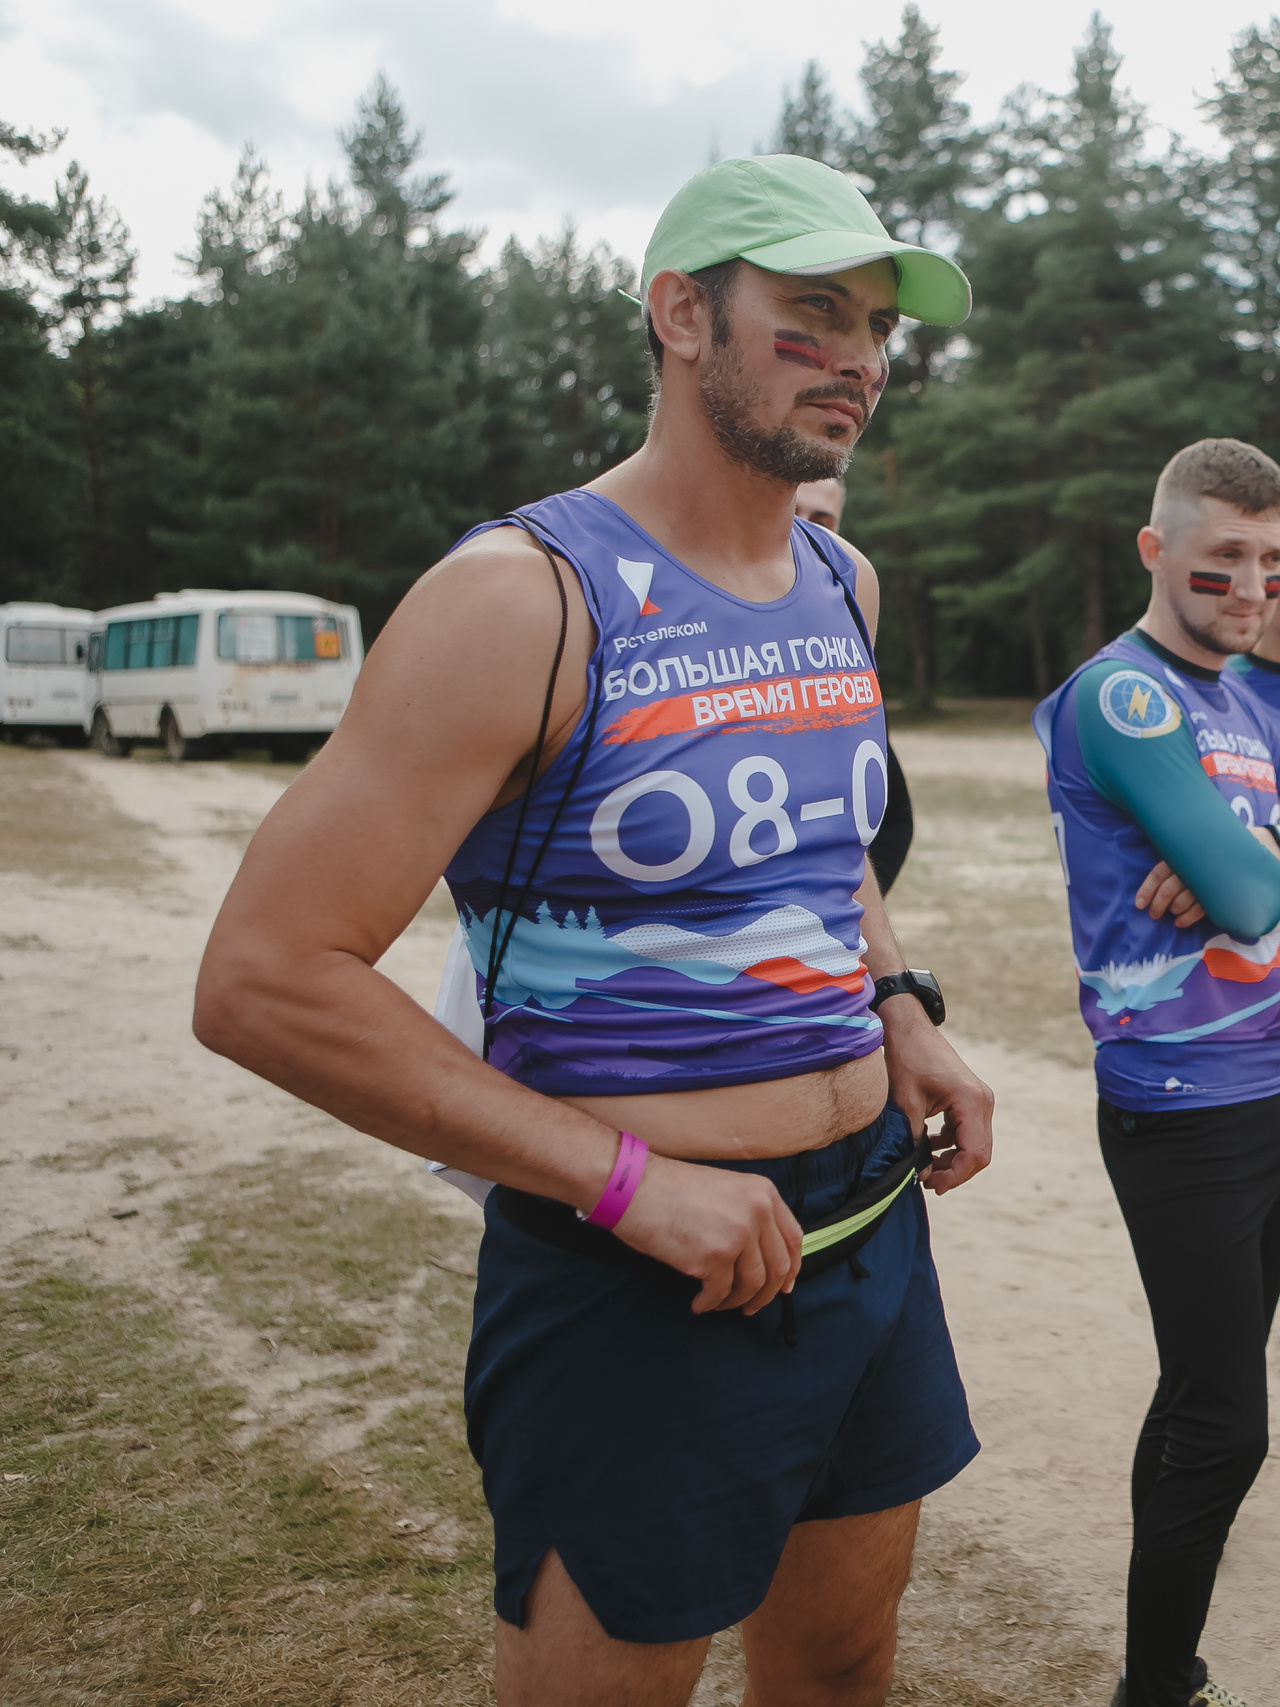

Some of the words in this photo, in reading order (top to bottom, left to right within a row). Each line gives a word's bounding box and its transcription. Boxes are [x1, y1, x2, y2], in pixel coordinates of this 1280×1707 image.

[603, 641, 784, 702] БОЛЬШАЯ
[788, 635, 866, 672] ГОНКА
[691, 681, 796, 726] ВРЕМЯ
[800, 675, 874, 709] ГЕРОЕВ
